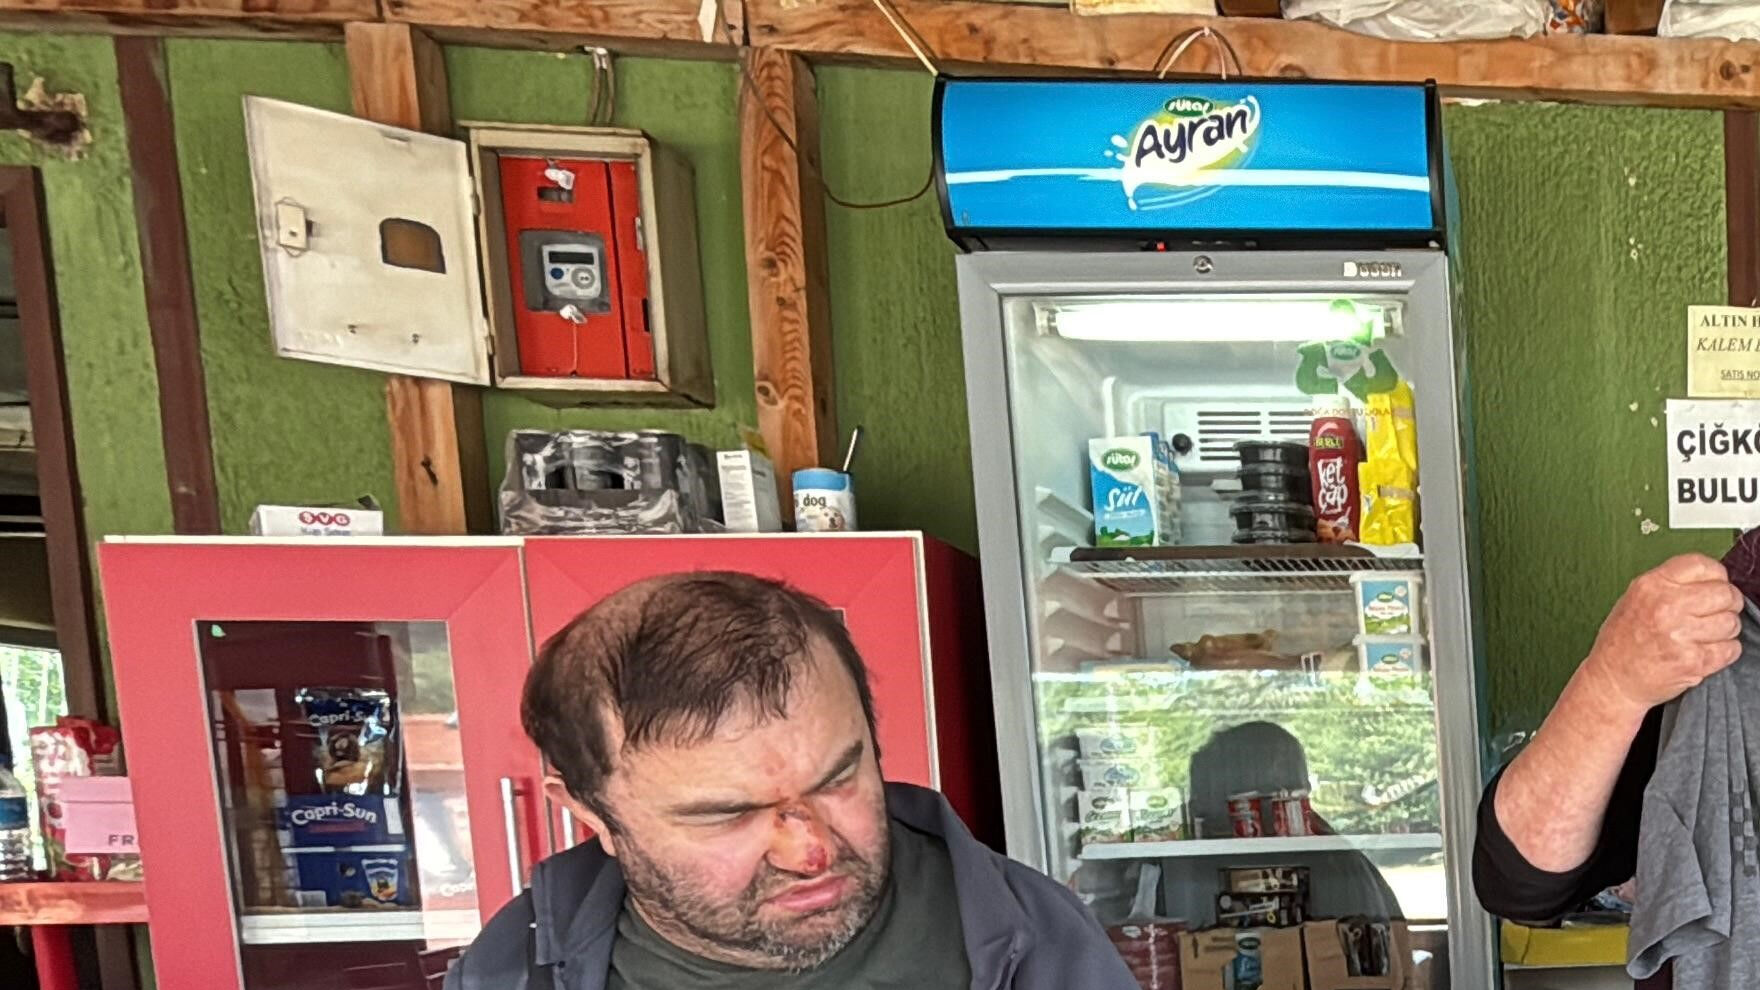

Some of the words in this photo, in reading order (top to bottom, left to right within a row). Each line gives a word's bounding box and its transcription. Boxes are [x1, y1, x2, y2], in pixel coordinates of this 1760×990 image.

[1135, 109, 1247, 168] Ayran
[1700, 313, 1748, 328] ALTIN
[1696, 337, 1752, 353] KALEM
[803, 494, 827, 508] dog
[308, 709, 366, 727] Capri-S
[291, 802, 377, 826] Capri-Sun
